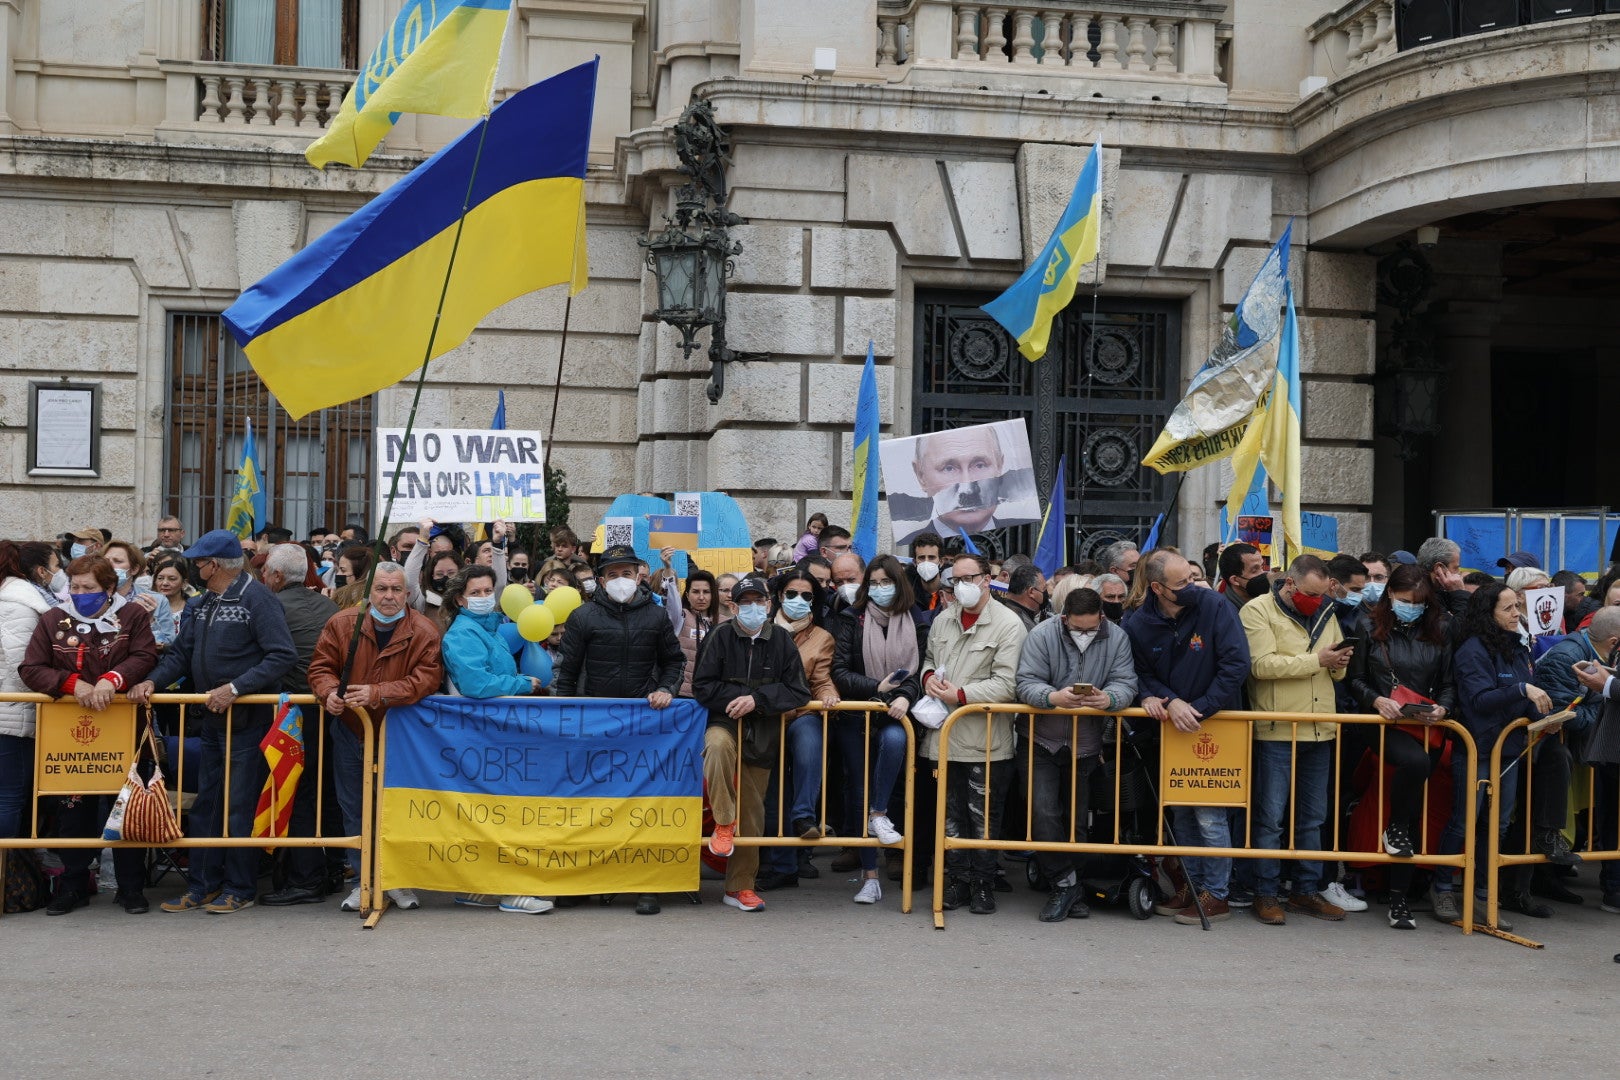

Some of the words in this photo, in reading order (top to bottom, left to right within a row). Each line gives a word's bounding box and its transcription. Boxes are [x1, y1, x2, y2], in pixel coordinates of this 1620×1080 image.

[386, 433, 441, 463] NO
[453, 434, 540, 464] WAR
[382, 471, 432, 498] IN
[436, 471, 472, 498] OUR
[474, 470, 544, 520] HOME
[1300, 513, 1322, 528] ATO
[418, 699, 543, 735] SERRAR
[558, 703, 594, 738] EL
[604, 700, 695, 738] SIELO
[45, 752, 124, 762] AJUNTAMENT
[45, 765, 61, 774] DE
[65, 763, 124, 774] VALÈNCIA
[439, 747, 541, 782] SOBRE
[566, 748, 698, 785] UCRANIA
[1169, 779, 1184, 788] DE
[1187, 778, 1241, 788] VALÈNCIA
[1170, 768, 1241, 777] AJUNTAMENT
[408, 799, 441, 821] NO
[457, 803, 506, 825] NOS
[522, 806, 614, 828] DEJEIS
[630, 807, 687, 828] SOLO
[429, 843, 480, 863] NOS
[497, 846, 577, 868] ESTAN
[588, 847, 689, 867] MATANDO
